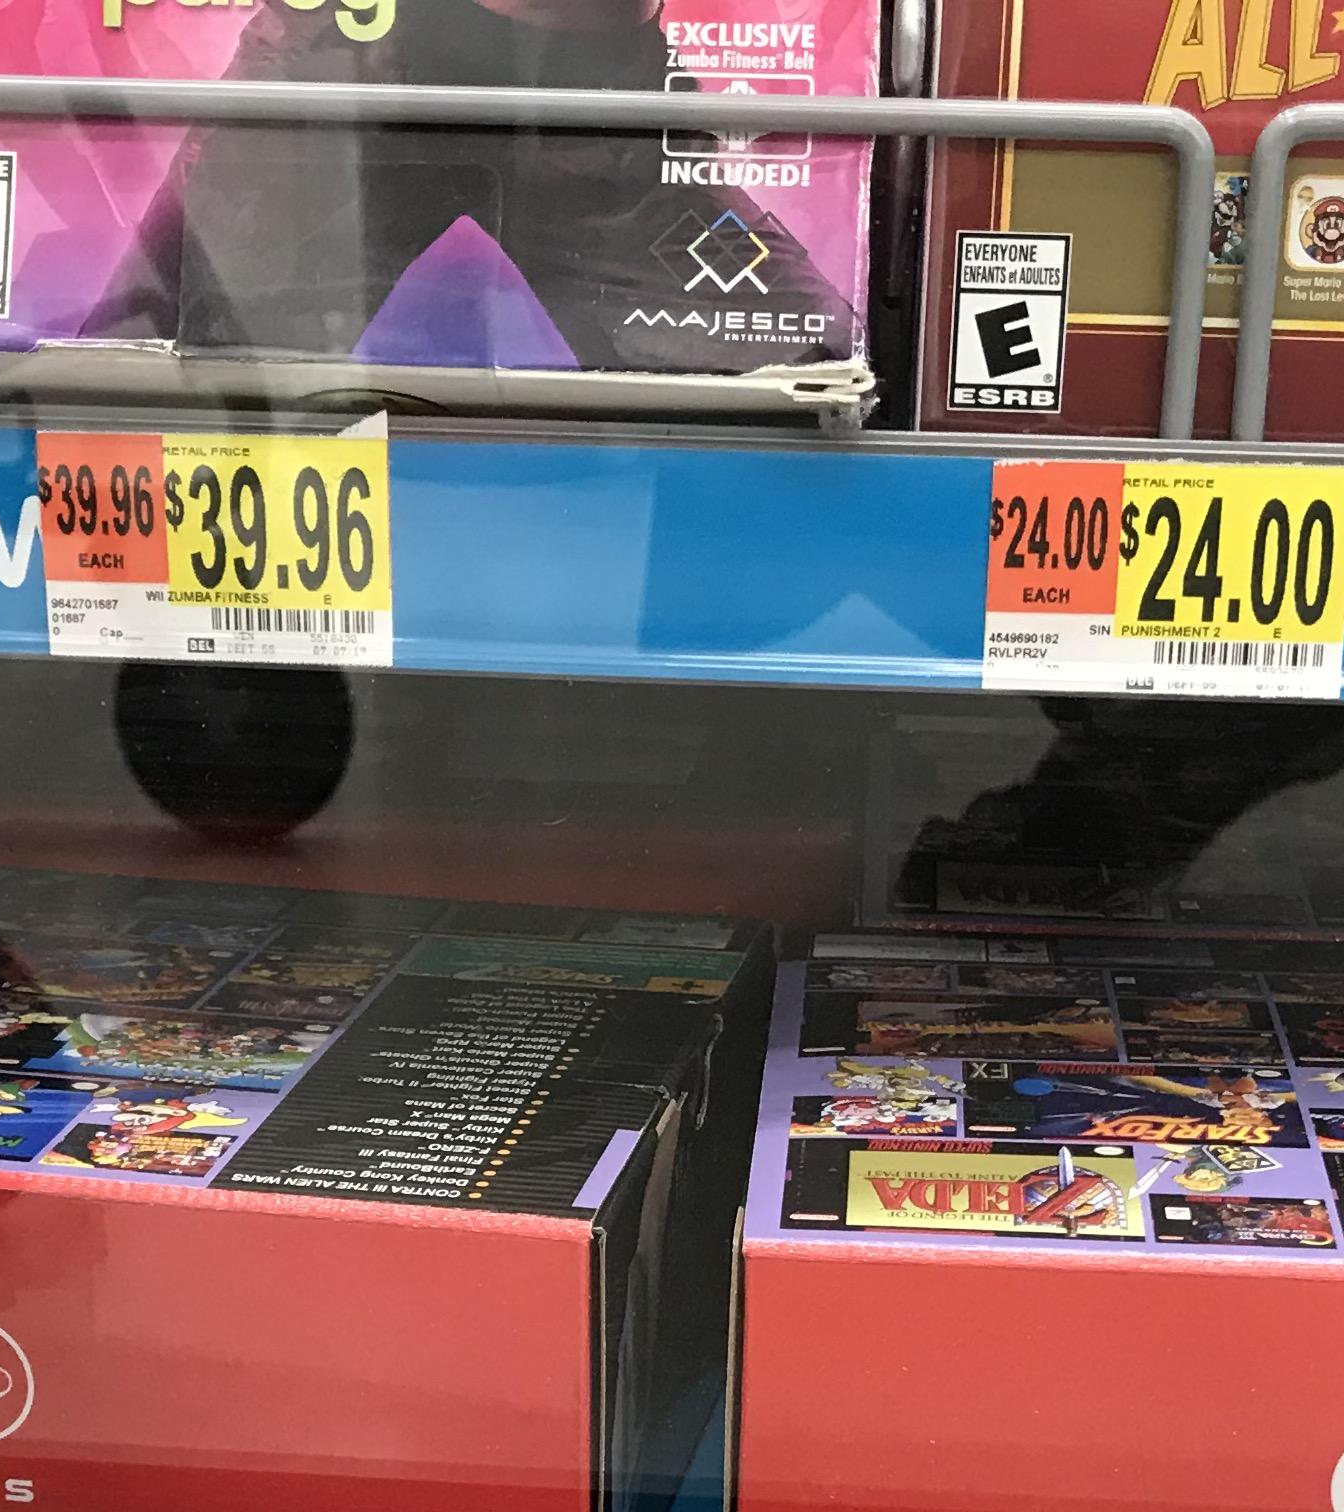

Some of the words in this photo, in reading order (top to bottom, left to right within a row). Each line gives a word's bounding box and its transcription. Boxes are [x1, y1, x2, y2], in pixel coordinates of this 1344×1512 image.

[666, 22, 815, 48] EXCLUSIVE
[666, 49, 719, 68] Zumba
[784, 52, 815, 71] Belt
[661, 161, 810, 187] INCLUDED!
[965, 243, 1037, 262] EVERYONE
[963, 266, 1006, 283] ENFANTS
[1008, 272, 1018, 284] et
[1019, 267, 1060, 285] ADULTES
[1283, 275, 1312, 289] Super
[1313, 276, 1341, 288] Mario
[1290, 289, 1306, 301] The
[1309, 290, 1329, 302] Lost
[624, 309, 825, 335] MAJESCO
[725, 333, 824, 344] ENTERTAINMENT
[975, 300, 1041, 378] E
[954, 387, 1054, 406] ESRB
[163, 446, 206, 456] RETAIL
[211, 446, 250, 457] PRICE
[1123, 478, 1168, 488] RETAIL
[1174, 478, 1214, 489] PRICE
[38, 464, 154, 537] $39.96
[165, 464, 373, 592] $39.96
[991, 496, 1109, 570] $24.00
[79, 553, 124, 569] EACH
[1120, 496, 1334, 625] $24.00
[168, 591, 211, 602] ZUMBA
[215, 592, 269, 604] FITNESS
[1023, 588, 1070, 603] EACH
[1089, 625, 1111, 636] SIN
[1121, 625, 1210, 638] PUNISHMENT
[1213, 627, 1221, 638] 2
[1274, 628, 1282, 639] E
[989, 647, 1047, 659] RVLPR2V
[968, 1062, 1009, 1079] FX
[377, 1149, 440, 1161] Fantasy
[443, 1155, 484, 1164] Final
[232, 1174, 280, 1184] WARS
[284, 1177, 335, 1188] ALIEN
[360, 1170, 404, 1181] Kong
[407, 1174, 469, 1186] Donkey
[336, 1182, 368, 1190] THE
[391, 1186, 461, 1198] CONTRA
[865, 1175, 1109, 1225] ZELDA
